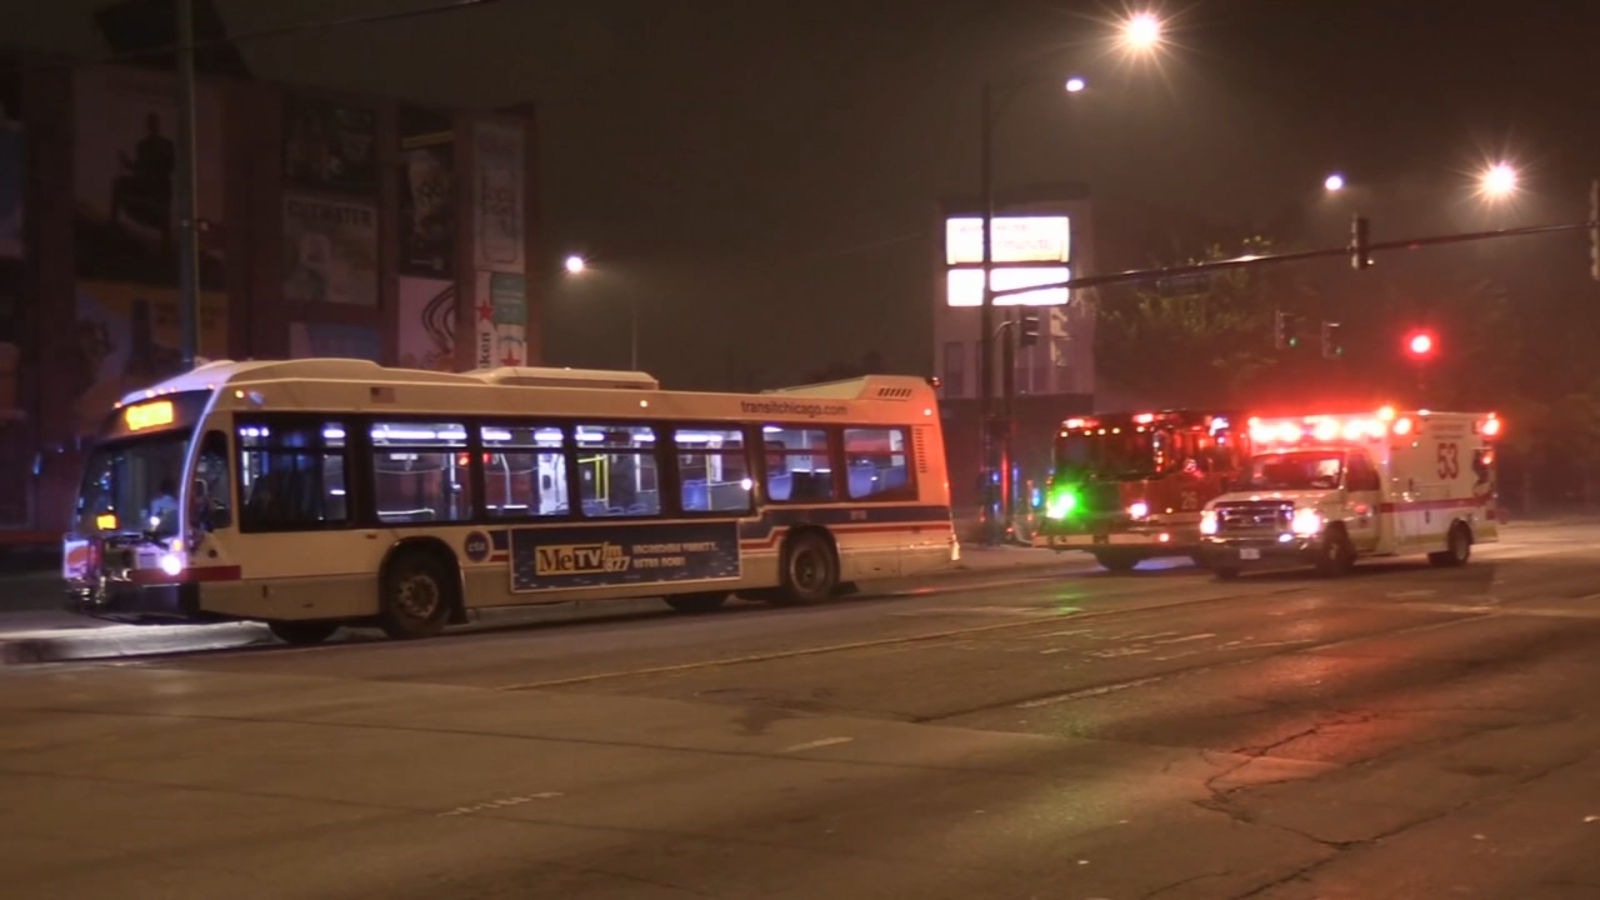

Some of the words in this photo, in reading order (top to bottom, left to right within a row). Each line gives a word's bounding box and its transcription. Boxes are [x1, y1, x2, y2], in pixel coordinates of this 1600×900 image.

[741, 401, 848, 418] transitchicago.com
[1436, 443, 1460, 480] 53
[539, 547, 602, 573] MeTV
